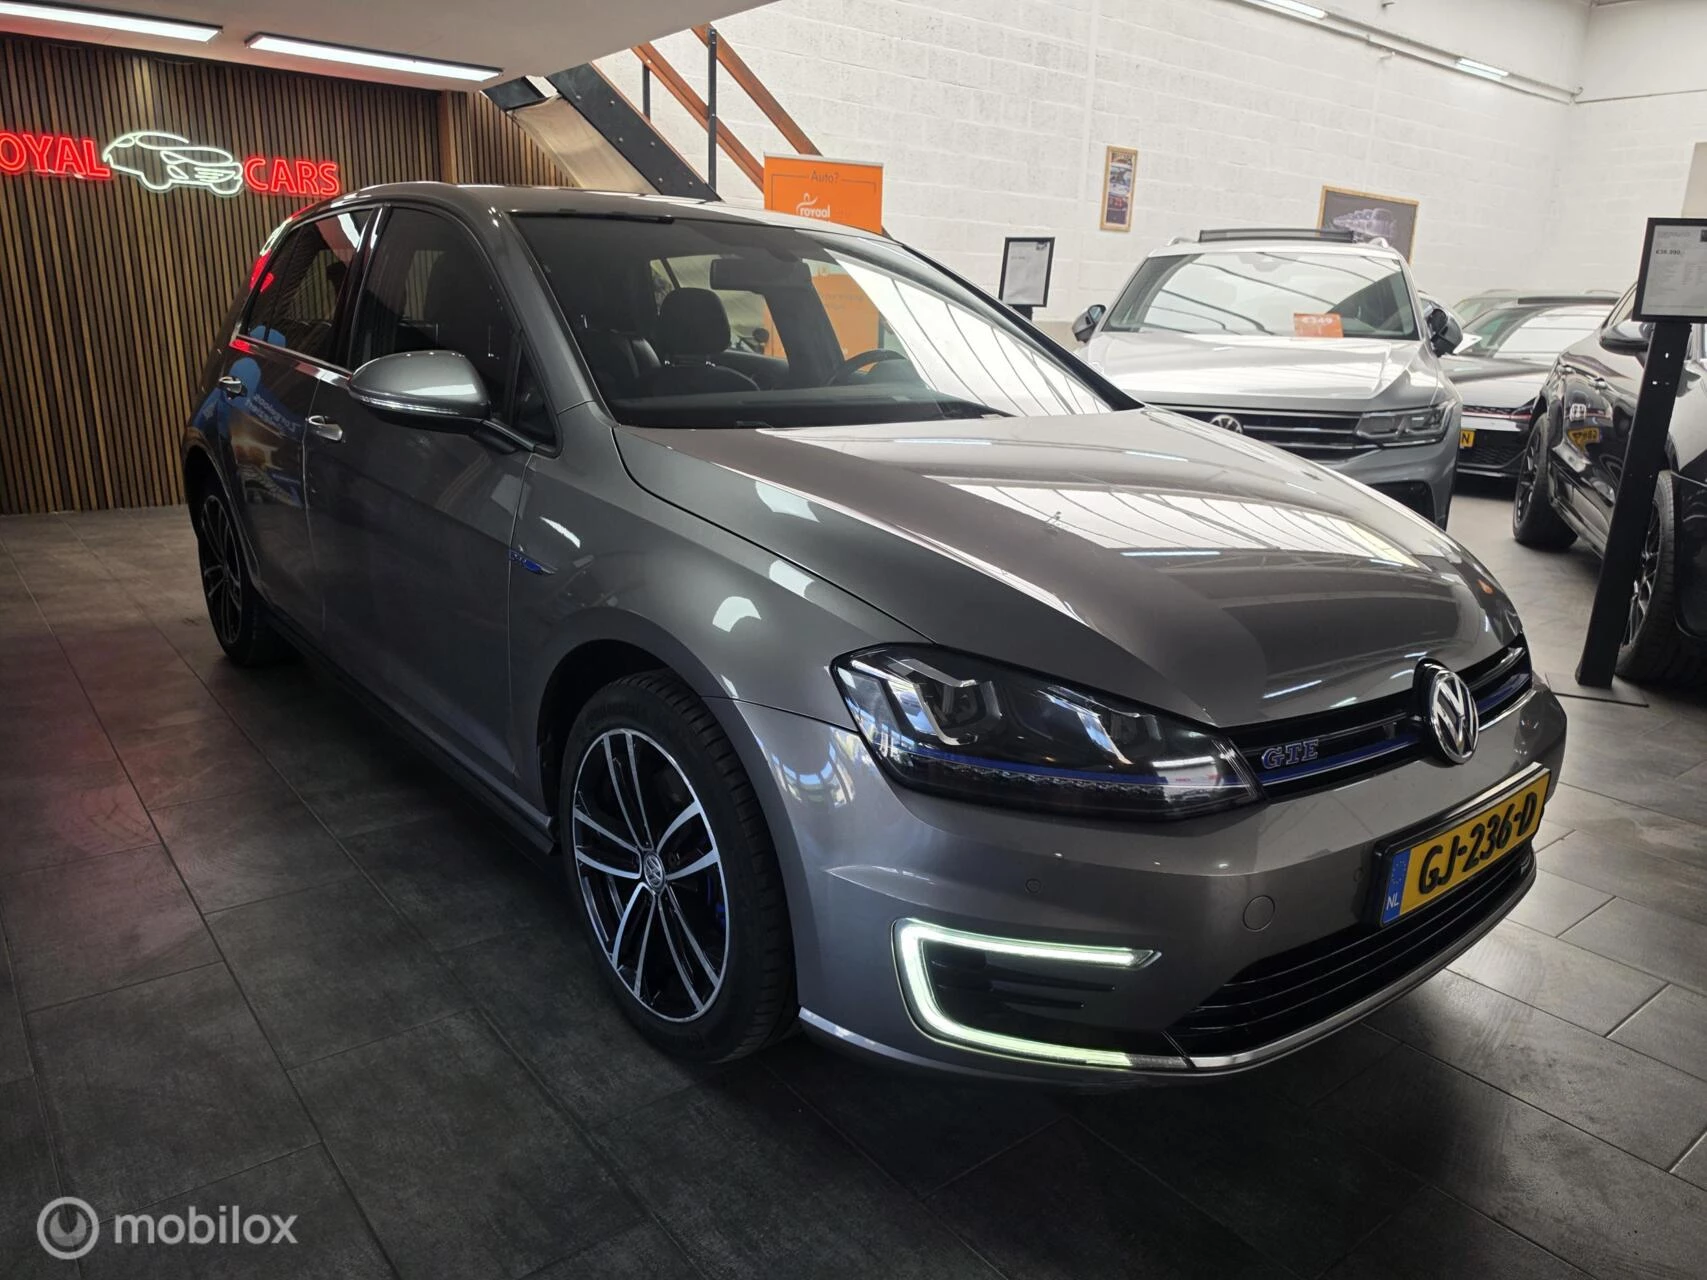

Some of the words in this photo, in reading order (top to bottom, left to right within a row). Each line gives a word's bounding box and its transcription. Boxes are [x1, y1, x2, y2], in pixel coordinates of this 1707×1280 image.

[0, 132, 111, 178] OYAL
[244, 157, 340, 196] CARS
[811, 170, 839, 184] Auto?
[1261, 738, 1320, 770] GTE
[1418, 791, 1538, 894] GJ-236-D
[1386, 891, 1400, 911] NL
